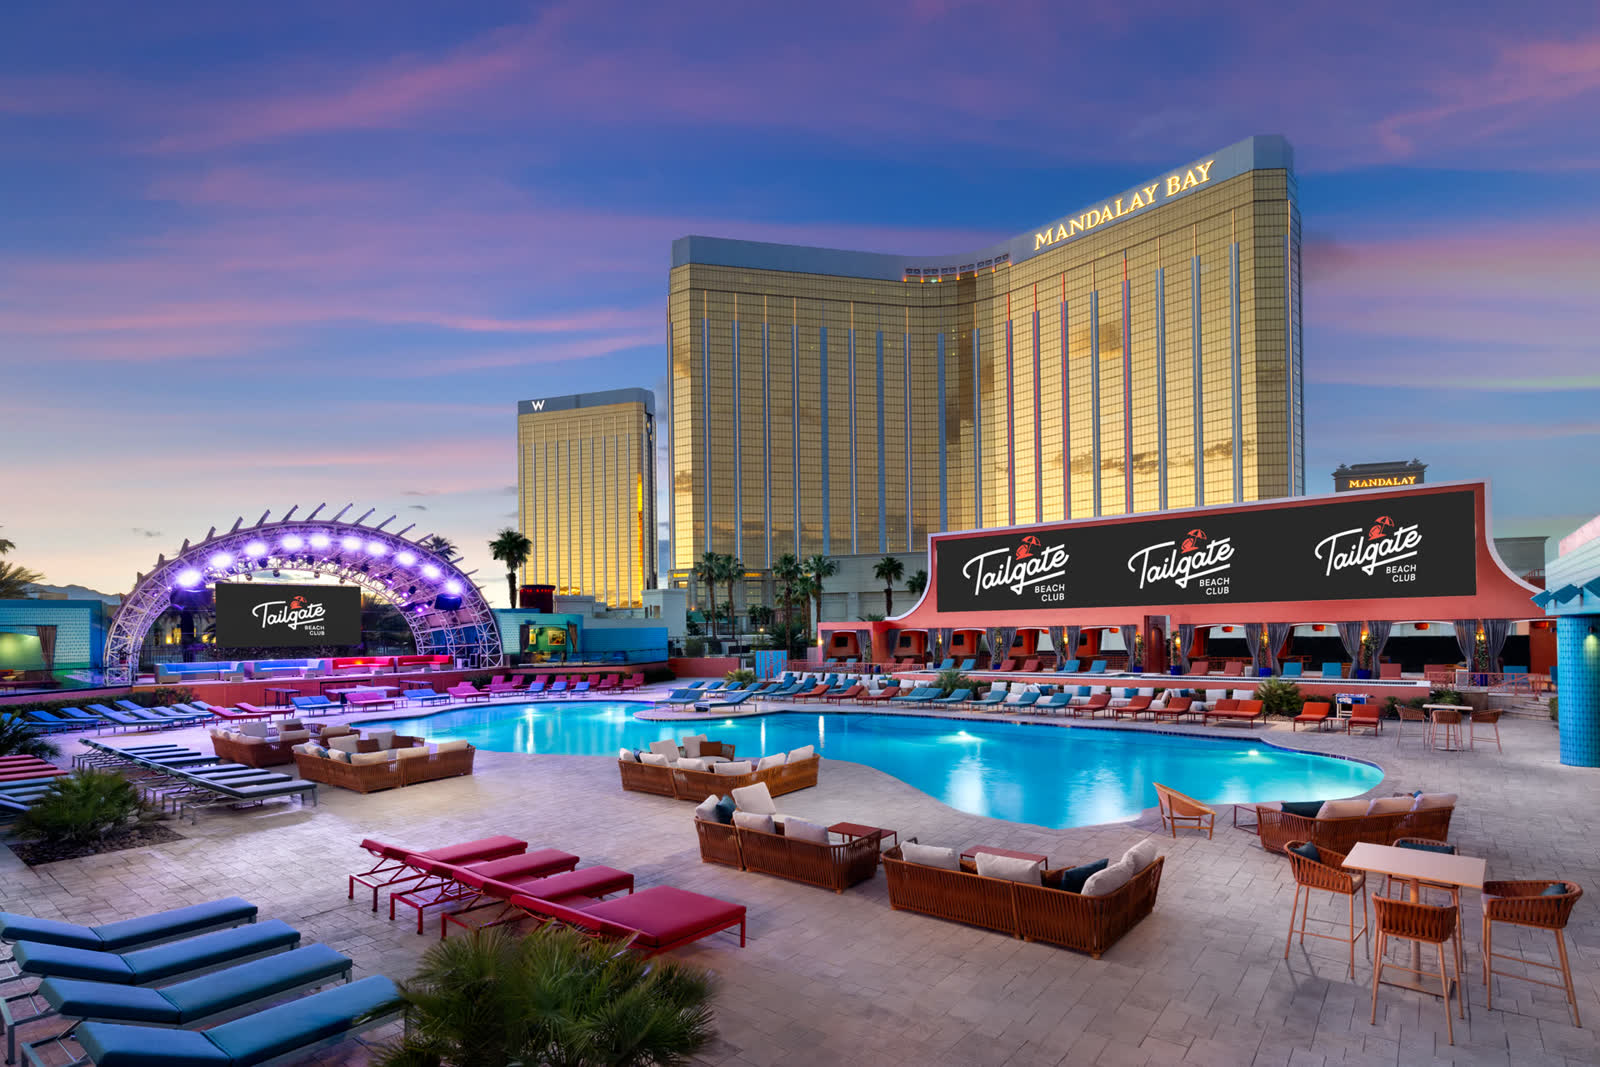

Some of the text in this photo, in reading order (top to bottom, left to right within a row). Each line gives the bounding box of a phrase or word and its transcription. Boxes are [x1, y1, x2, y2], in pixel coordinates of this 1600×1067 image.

[1034, 160, 1215, 251] MANDALAY BAY
[531, 399, 546, 412] W
[1349, 476, 1416, 488] MANDALAY
[1314, 523, 1423, 577] Tailgate
[1128, 538, 1235, 589] Tailgate
[1386, 564, 1416, 575] BEACH
[963, 544, 1069, 596] Tailgate
[1200, 578, 1230, 588] BEACH
[1393, 573, 1416, 583] CLUB
[1034, 583, 1066, 594] BEACH
[1206, 587, 1230, 596] CLUB
[1040, 593, 1066, 602] CLUB
[251, 600, 326, 631] Tailgate
